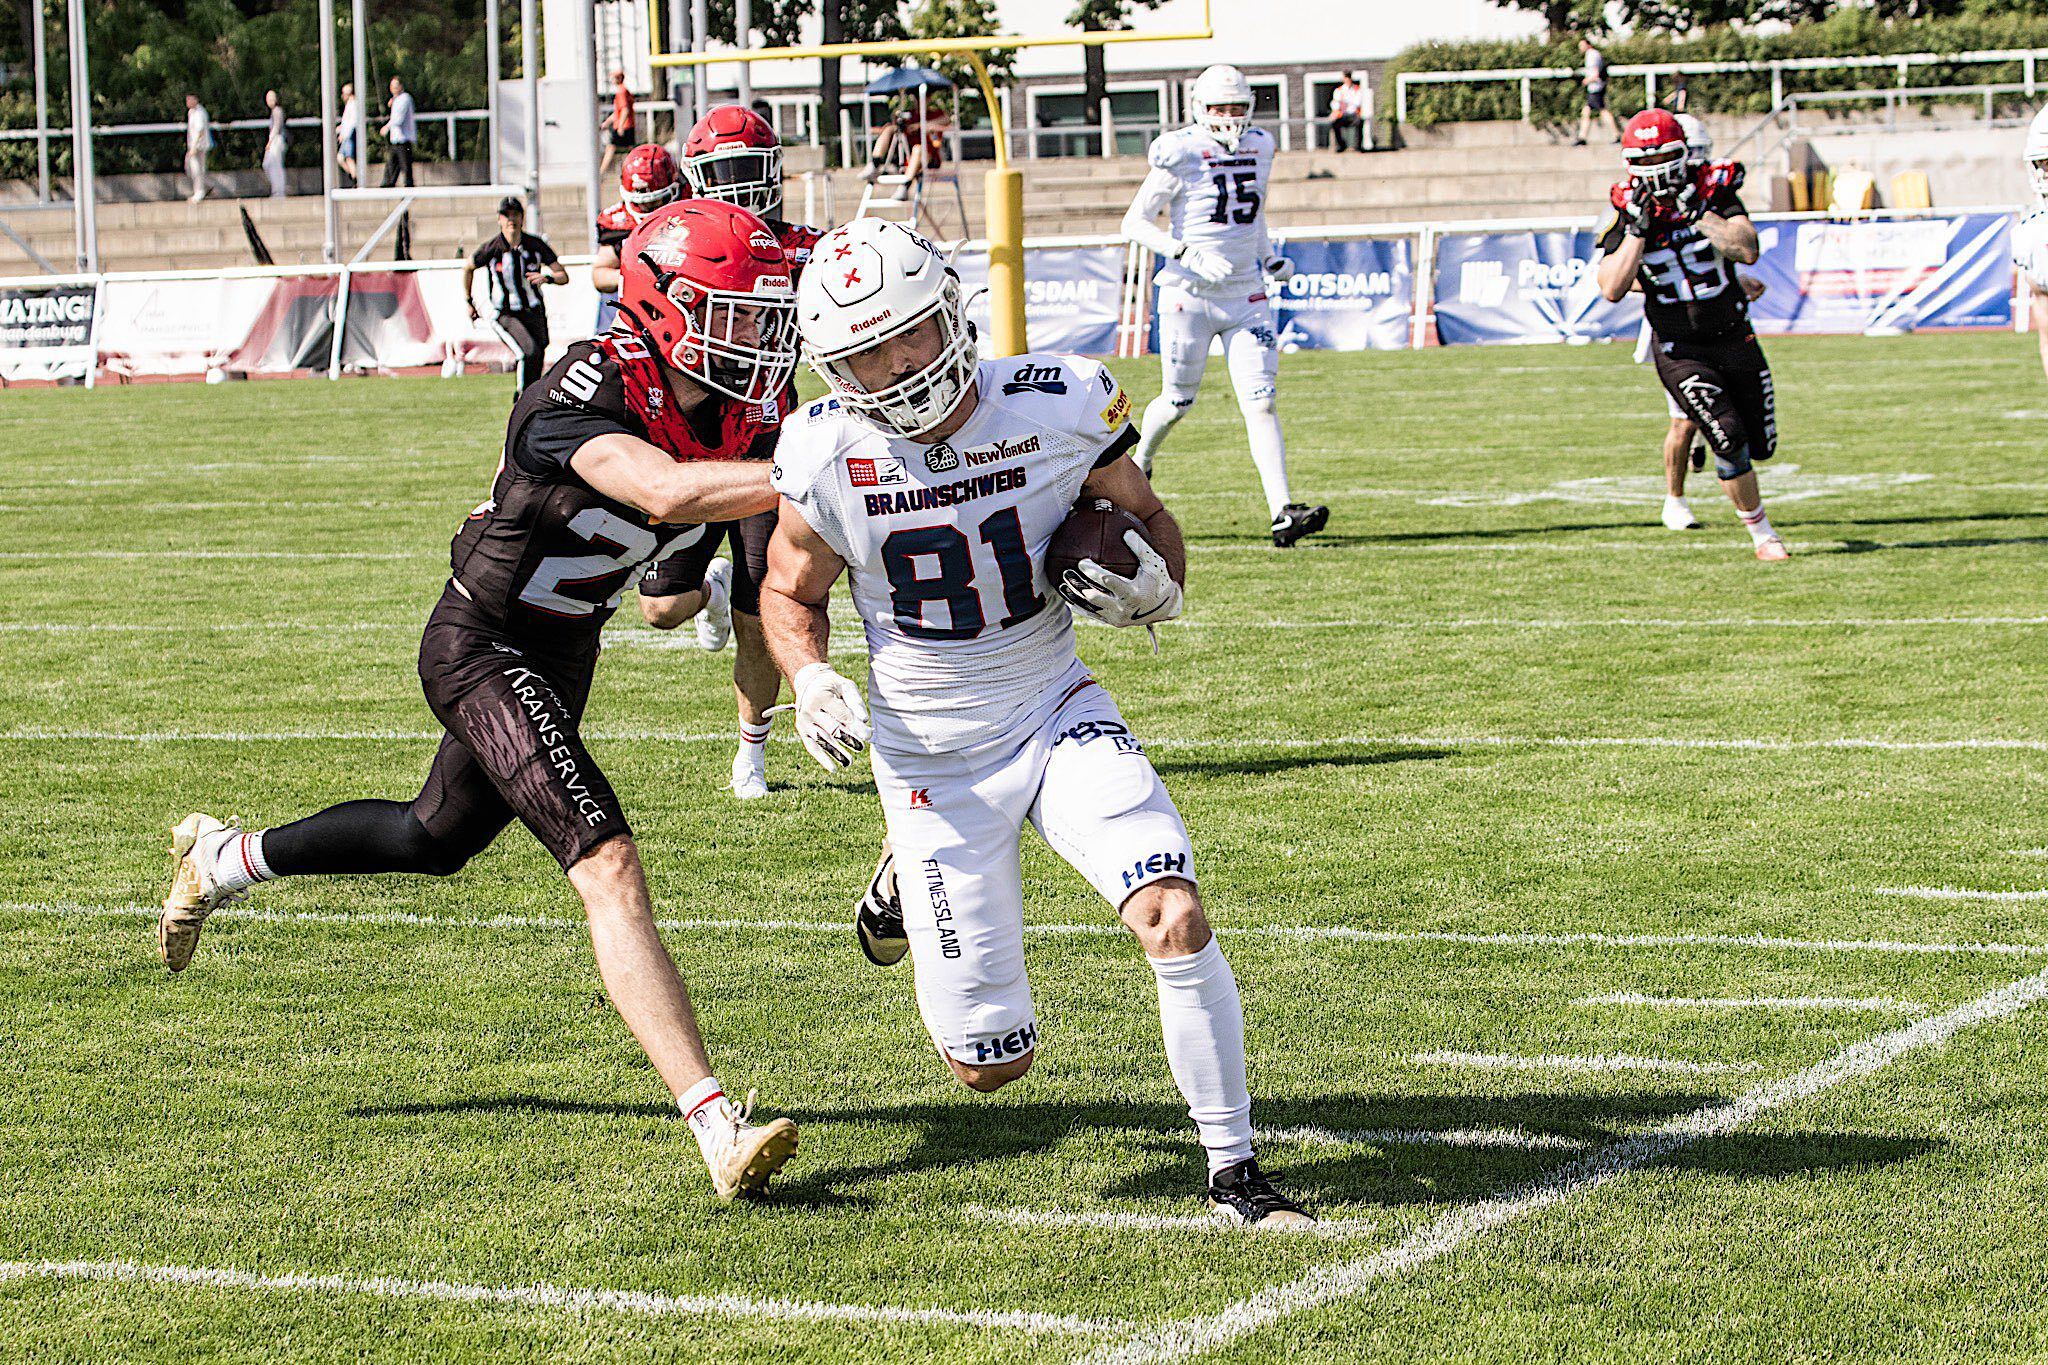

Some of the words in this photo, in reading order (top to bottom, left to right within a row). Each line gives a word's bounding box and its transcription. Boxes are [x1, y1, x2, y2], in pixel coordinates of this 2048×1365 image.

[1209, 172, 1261, 224] 15
[1276, 272, 1391, 297] OTSDAM
[850, 309, 892, 333] Riddell
[1013, 363, 1062, 382] dm
[863, 465, 1027, 517] BRAUNSCHWEIG
[879, 474, 905, 483] GFL
[880, 505, 1048, 640] 81
[921, 858, 962, 960] FITNESSLAND
